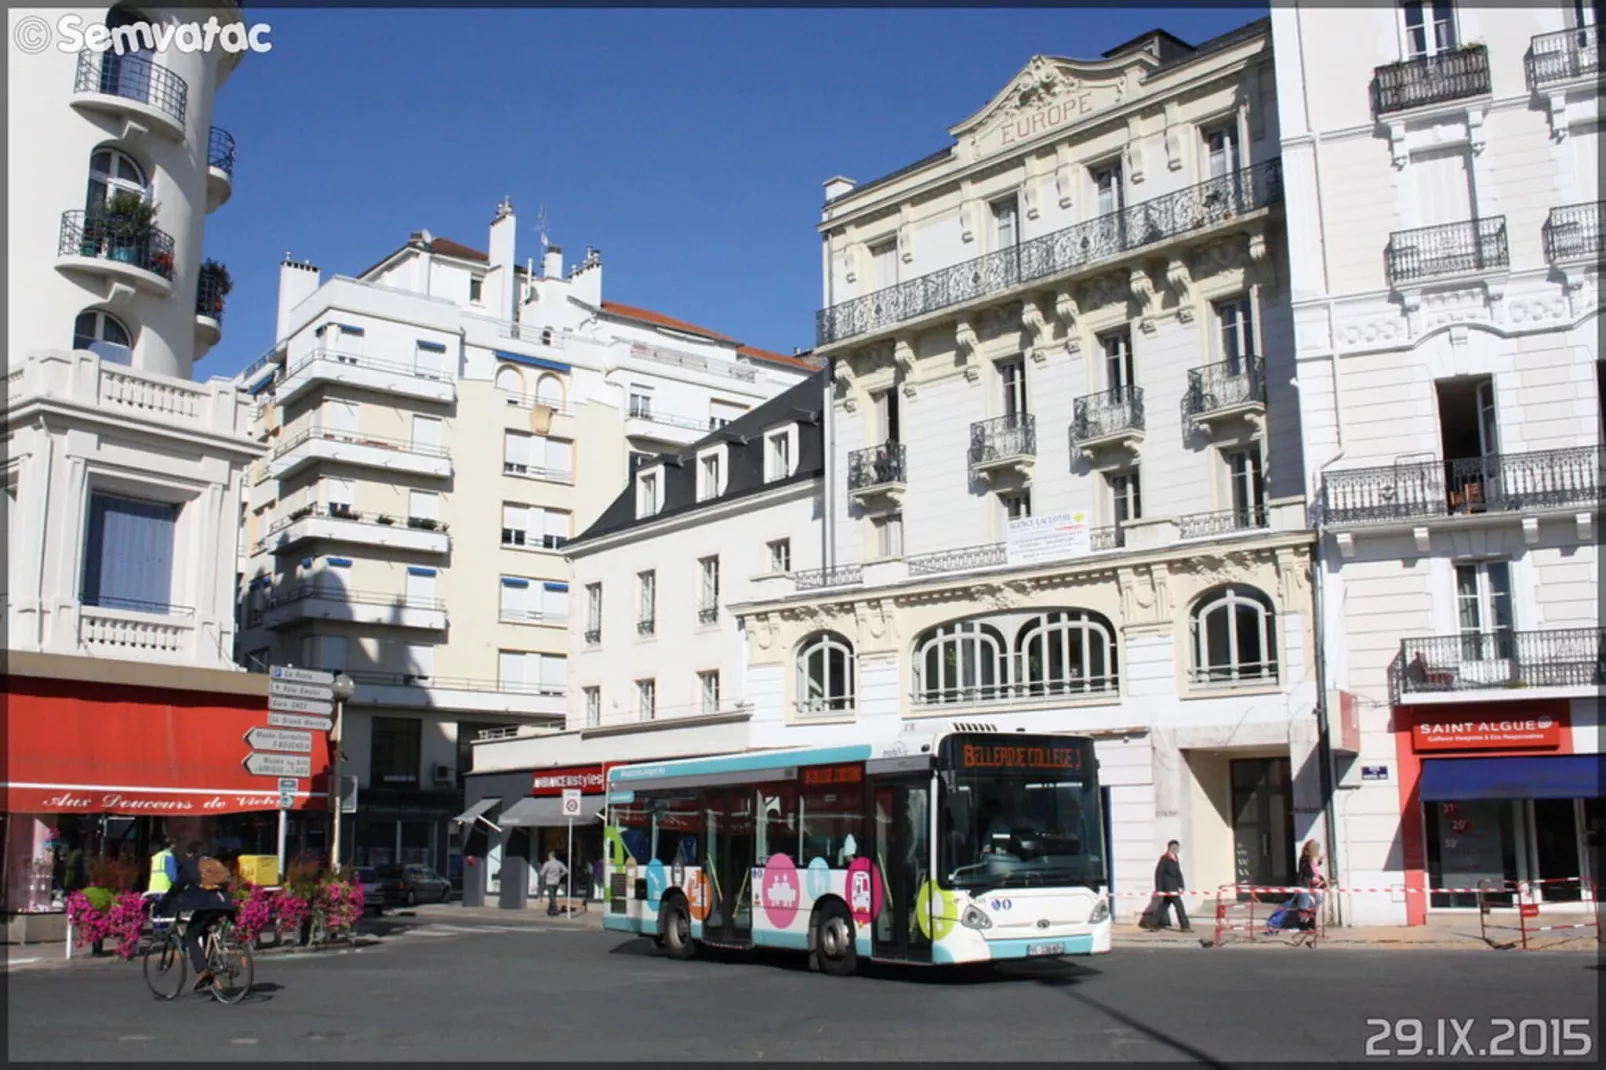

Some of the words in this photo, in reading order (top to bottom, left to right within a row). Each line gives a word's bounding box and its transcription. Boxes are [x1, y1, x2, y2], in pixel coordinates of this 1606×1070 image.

[1001, 92, 1092, 145] EUROPE
[1420, 722, 1473, 734] SAINT
[1478, 720, 1536, 732] ALGUE
[43, 793, 92, 808] Aux
[101, 793, 193, 810] Douceurs
[203, 796, 227, 809] de
